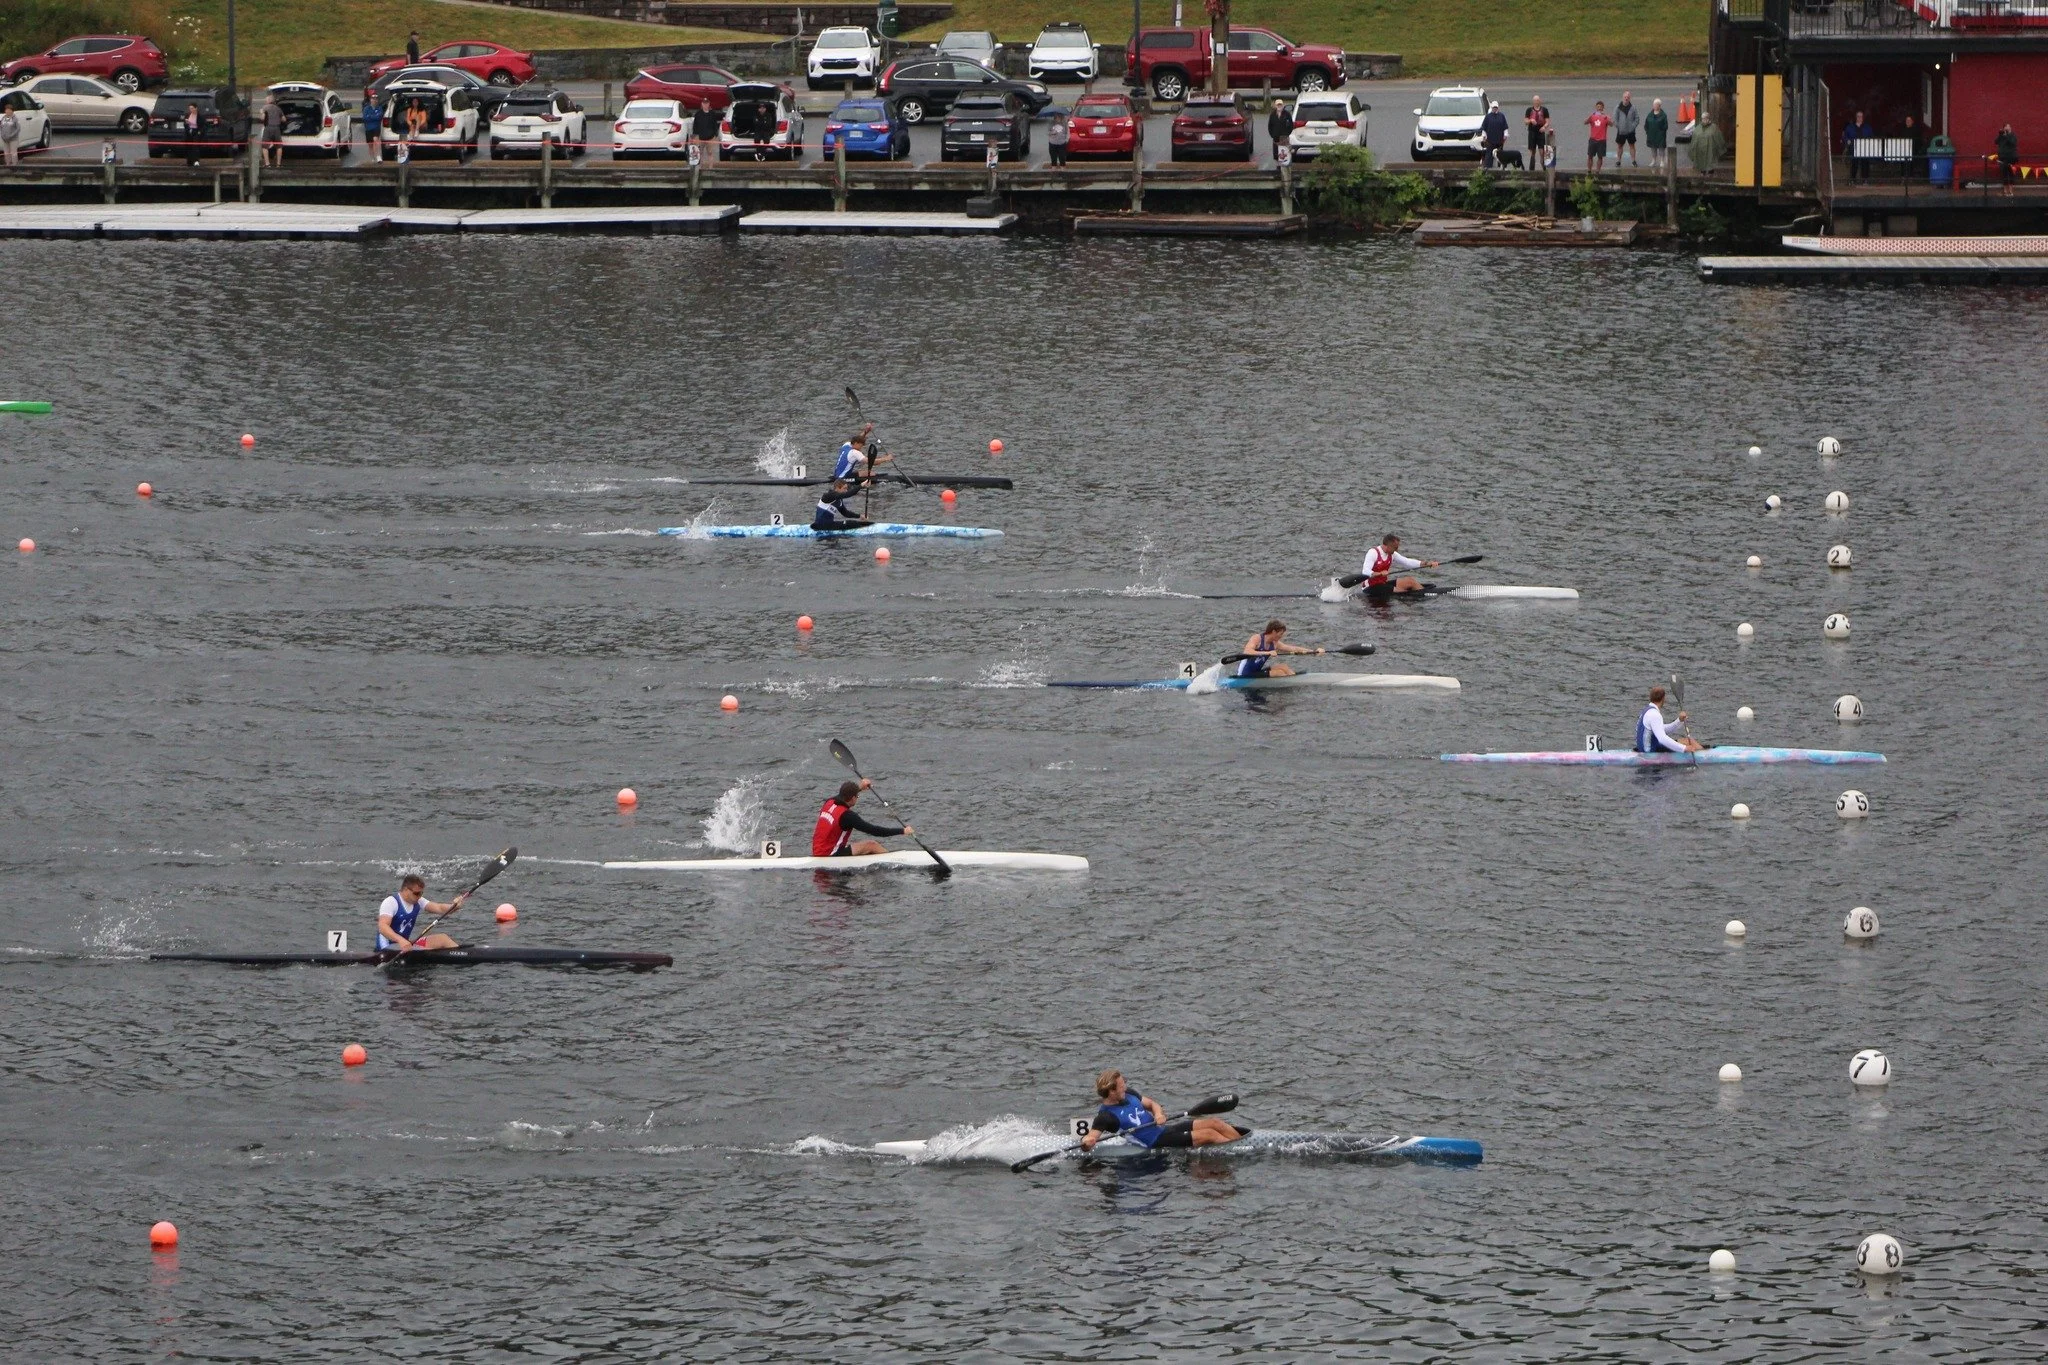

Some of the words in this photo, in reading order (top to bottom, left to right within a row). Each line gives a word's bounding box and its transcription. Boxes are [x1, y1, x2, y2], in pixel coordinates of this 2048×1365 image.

[795, 465, 801, 478] 1
[773, 513, 782, 526] 2
[1831, 549, 1840, 564] 2
[1827, 616, 1836, 629] 3
[1183, 664, 1195, 677] 4
[1853, 702, 1862, 716] 4
[1837, 794, 1848, 811] 5
[1856, 794, 1868, 812] 5
[765, 842, 776, 856] 6
[1859, 914, 1873, 932] 6
[333, 932, 343, 948] 7
[1854, 1056, 1871, 1078] 7
[1874, 1053, 1888, 1076] 7
[1076, 1120, 1089, 1136] 8
[1858, 1242, 1870, 1266] 8
[1884, 1243, 1900, 1268] 8
